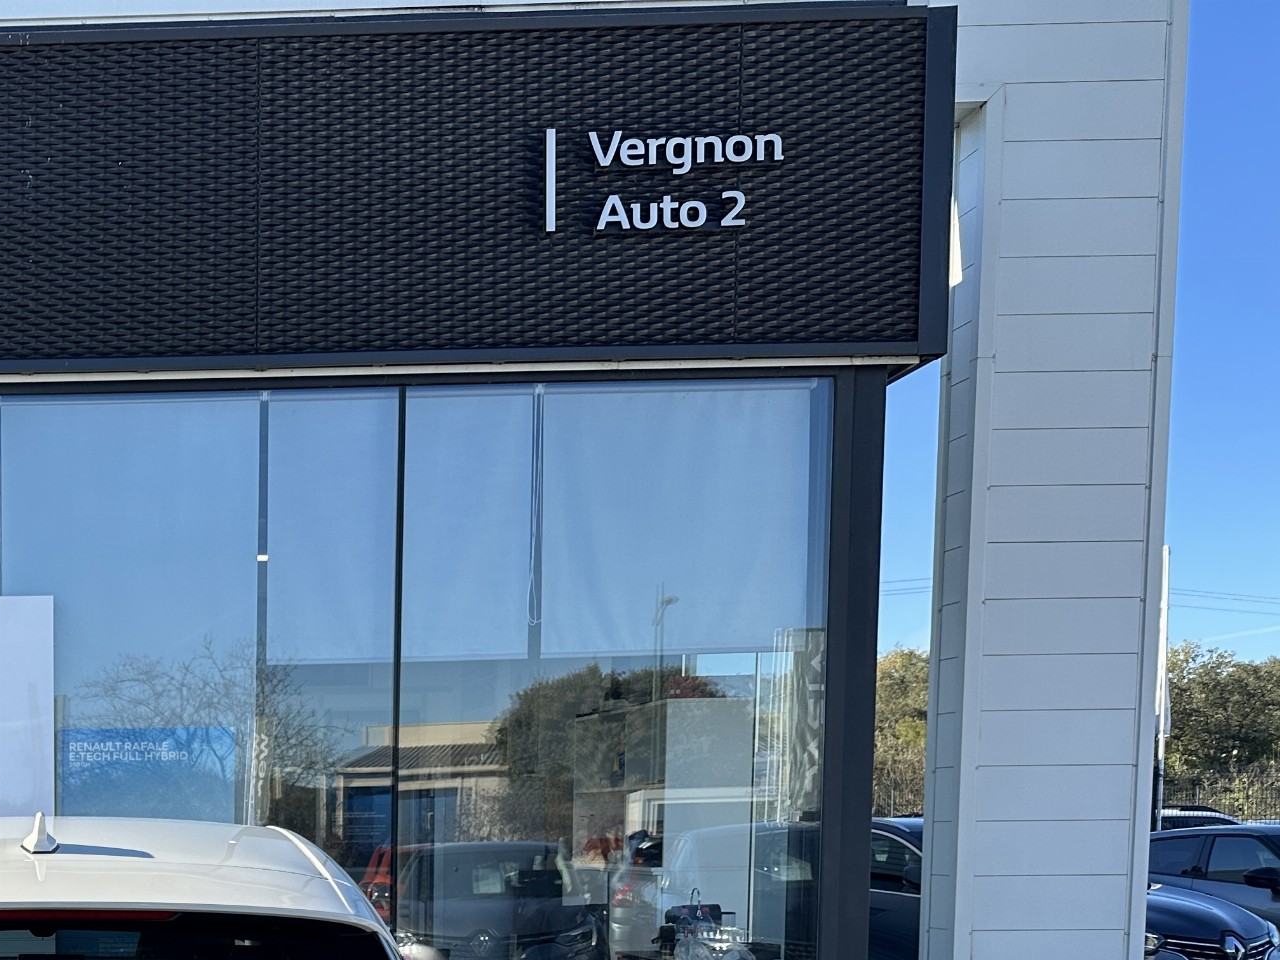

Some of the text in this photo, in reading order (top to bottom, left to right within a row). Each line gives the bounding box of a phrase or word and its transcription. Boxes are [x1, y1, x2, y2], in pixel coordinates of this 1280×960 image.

[588, 130, 785, 175] Vergnon
[596, 190, 747, 230] Auto 2
[68, 741, 170, 751] RENAULT RAFALE
[68, 751, 189, 761] E-TECH FULL HYBRID
